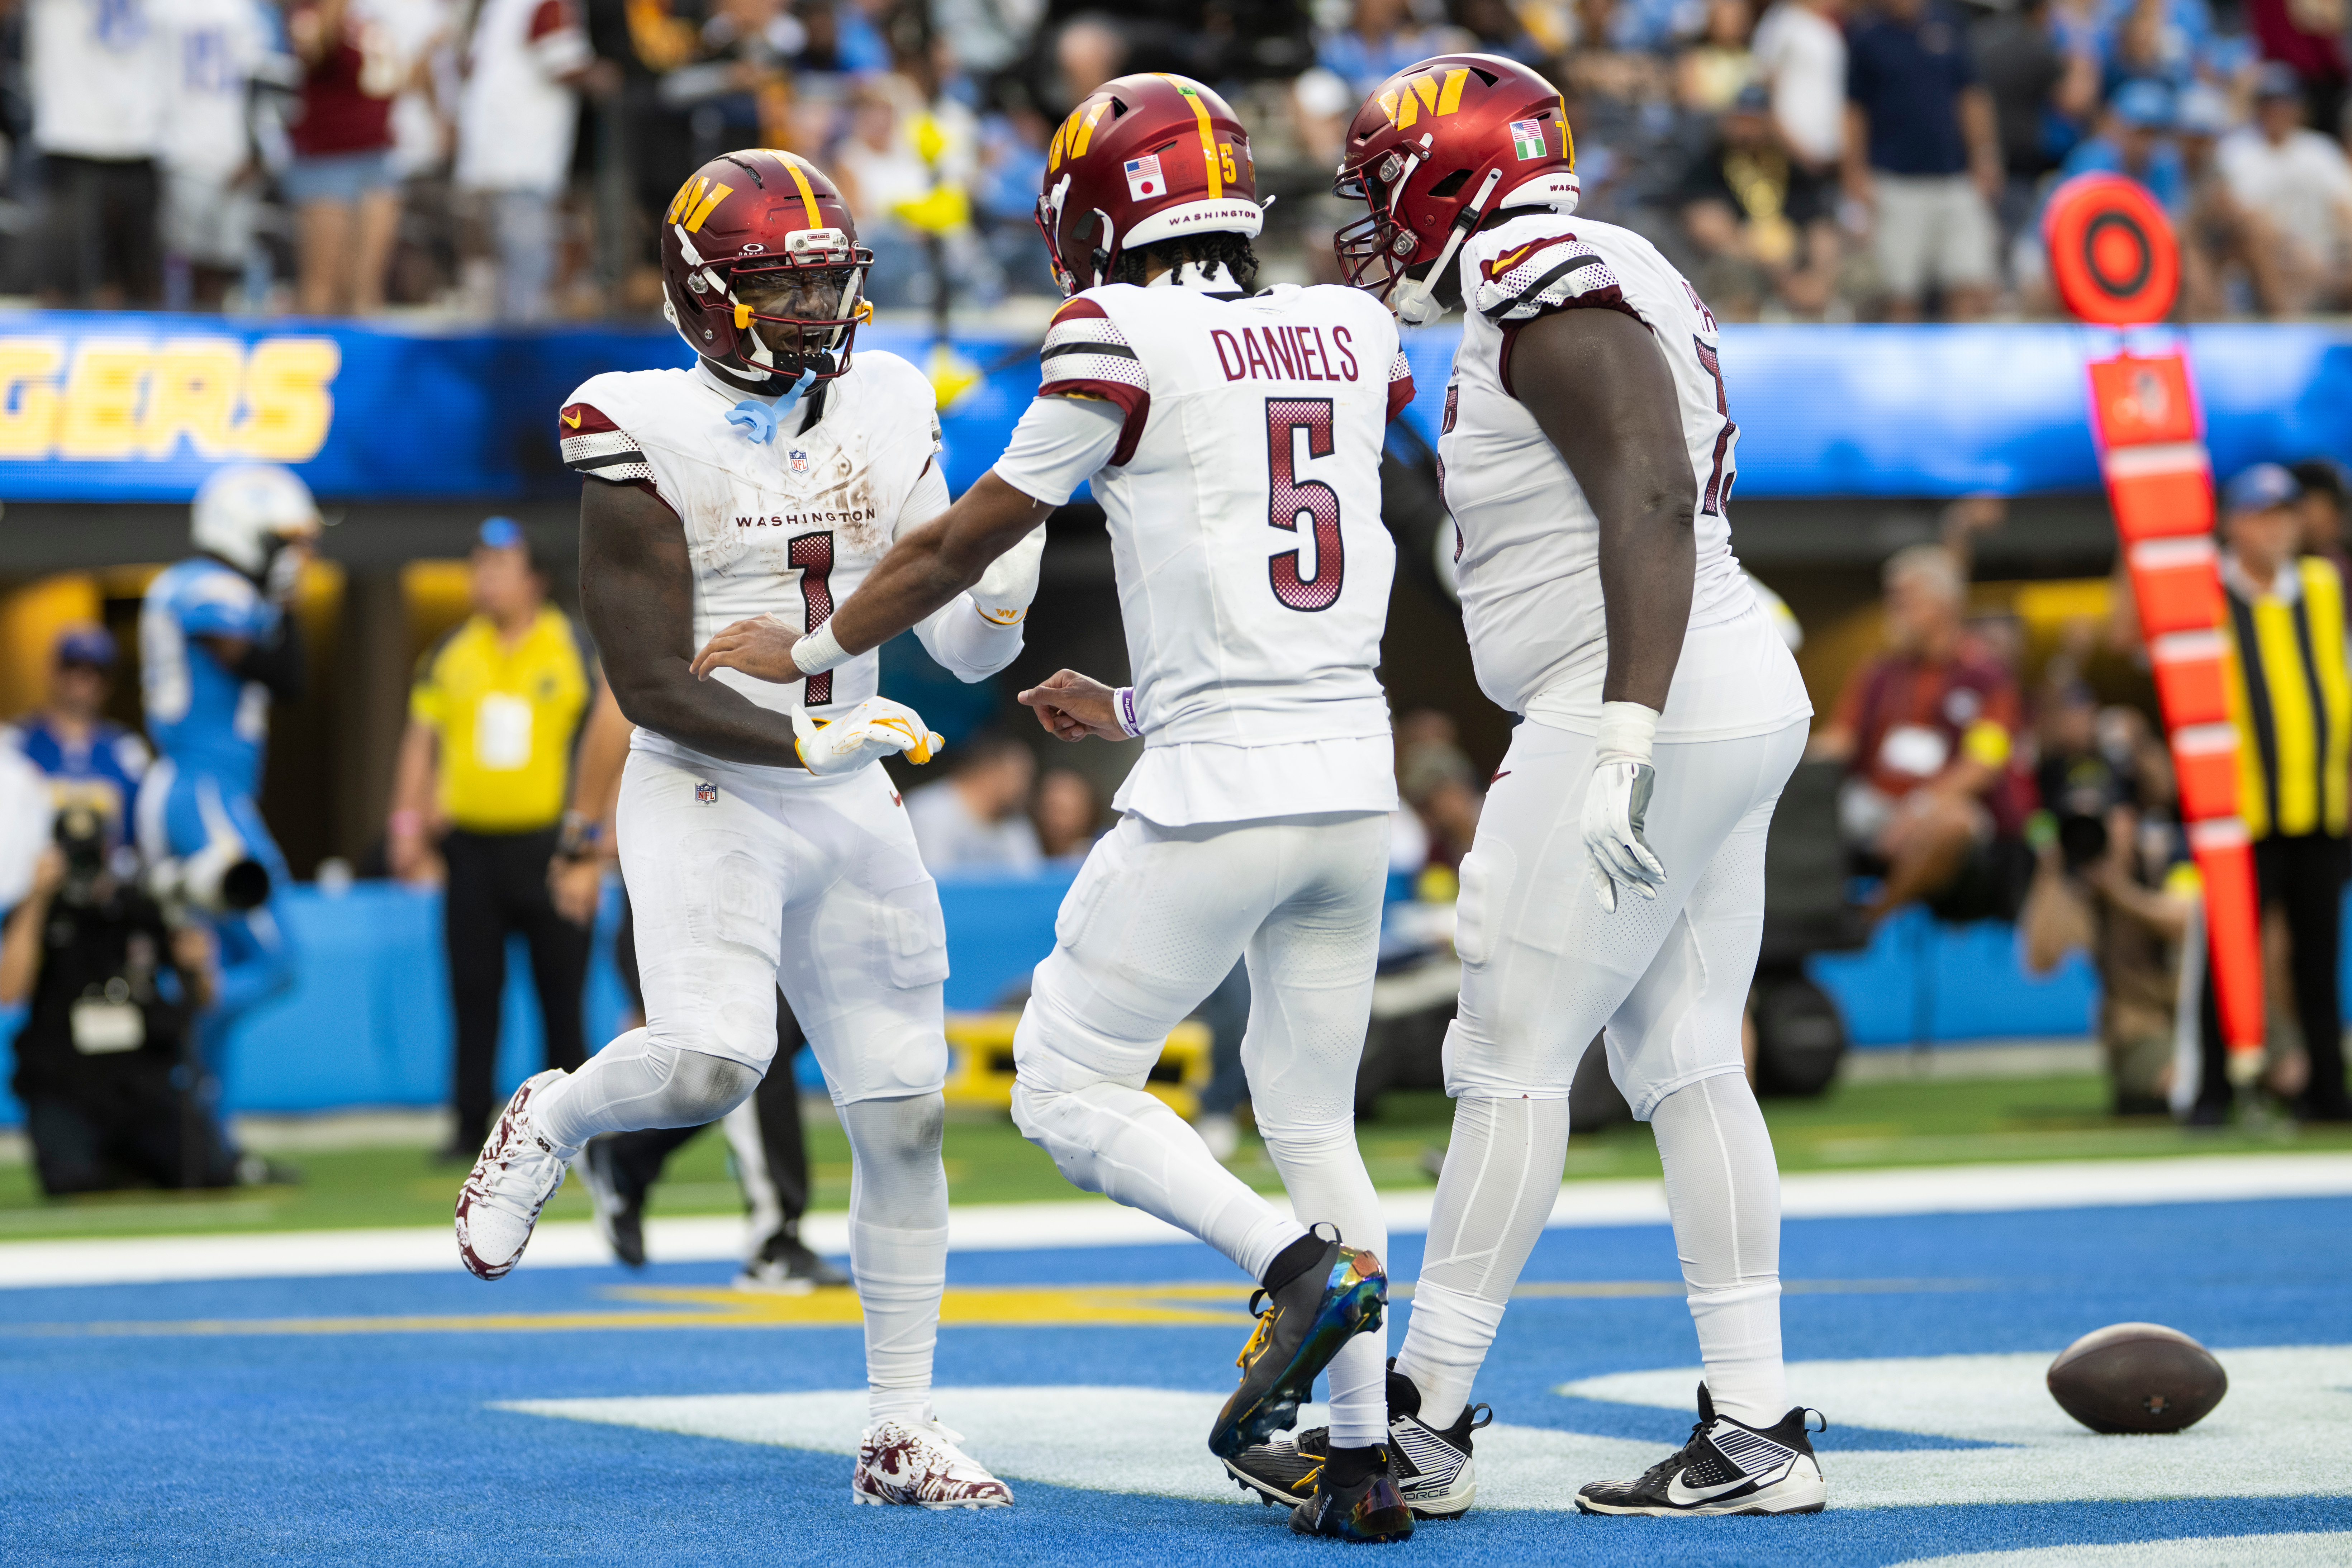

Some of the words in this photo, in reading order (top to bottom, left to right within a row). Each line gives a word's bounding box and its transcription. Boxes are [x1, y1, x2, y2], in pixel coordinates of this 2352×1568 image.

[1219, 143, 1236, 184] 5
[1169, 210, 1256, 225] WASHINGTON
[1210, 326, 1358, 381] DANIELS
[792, 459, 807, 471] NFL
[1265, 397, 1344, 612] 5
[736, 508, 875, 527] WASHINGTON
[788, 530, 834, 708] 1
[698, 791, 714, 800] NFL
[542, 1135, 557, 1148] JORDAN
[1402, 1487, 1450, 1500] ORCE
[1321, 1494, 1332, 1513] ZOOM
